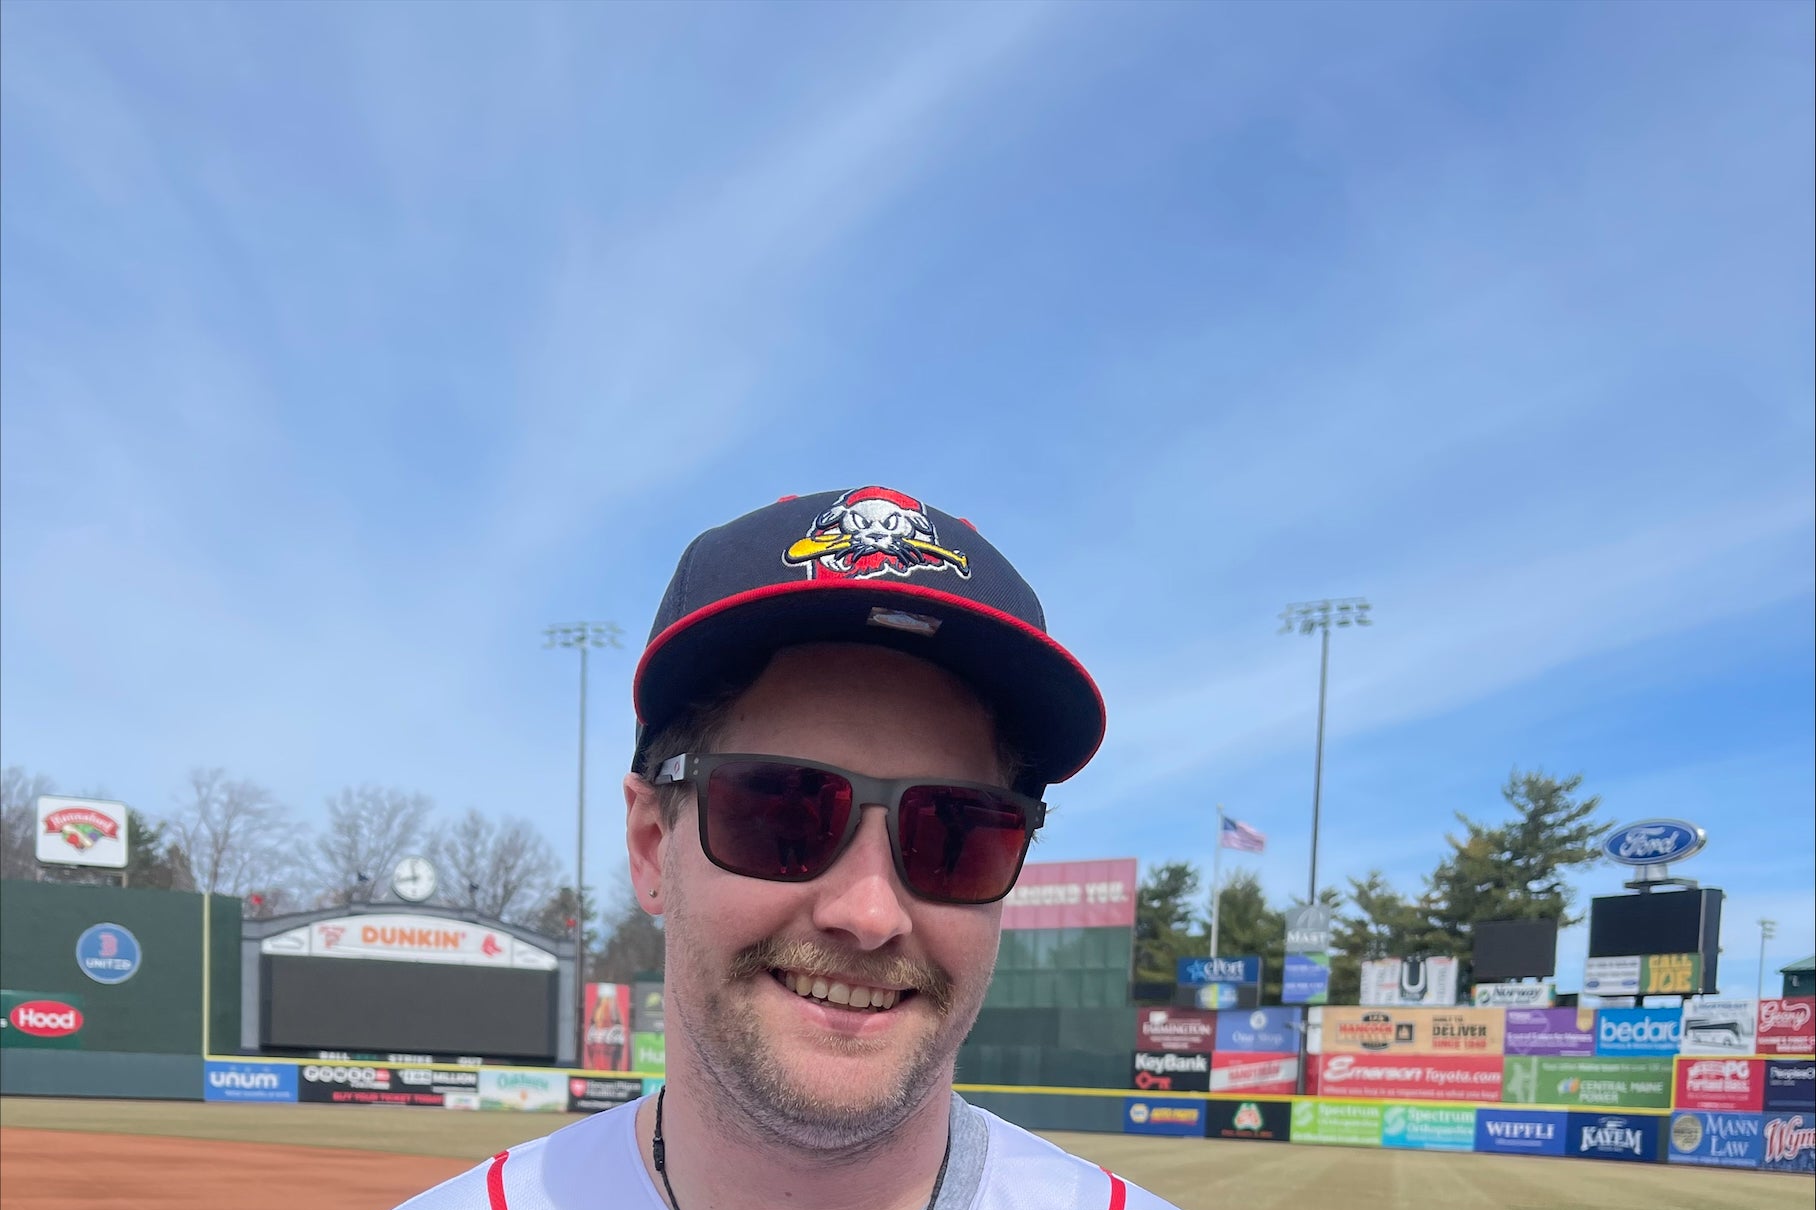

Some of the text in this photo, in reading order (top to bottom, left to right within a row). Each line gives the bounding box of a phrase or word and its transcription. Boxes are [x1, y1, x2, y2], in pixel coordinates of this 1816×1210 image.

[1619, 826, 1679, 857] Ford
[361, 925, 466, 949] DUNKIN'
[85, 957, 132, 971] UNITED
[1648, 953, 1693, 968] CALL
[1647, 968, 1693, 994] JOE
[1491, 985, 1542, 999] Norway
[18, 1007, 76, 1030] Hood
[1231, 1031, 1283, 1045] One Stop
[1432, 1024, 1487, 1037] DELIVER
[318, 1050, 350, 1061] BALL
[387, 1053, 434, 1065] STRIKE
[457, 1056, 483, 1066] OUT
[1135, 1052, 1208, 1075] KeyBank
[432, 1071, 477, 1085] MILLION
[1323, 1056, 1501, 1086] Emerson Toyota.com
[209, 1071, 279, 1089] unum
[1580, 1080, 1663, 1093] CENTRAL MAINE
[1580, 1092, 1619, 1104] POWER
[1318, 1103, 1379, 1118] Spectrum
[1407, 1106, 1473, 1123] Spectrum
[1486, 1120, 1556, 1140] WIPFLI
[1705, 1113, 1759, 1139] MANN
[1580, 1126, 1643, 1155] KAYEM
[1711, 1135, 1750, 1158] LAW
